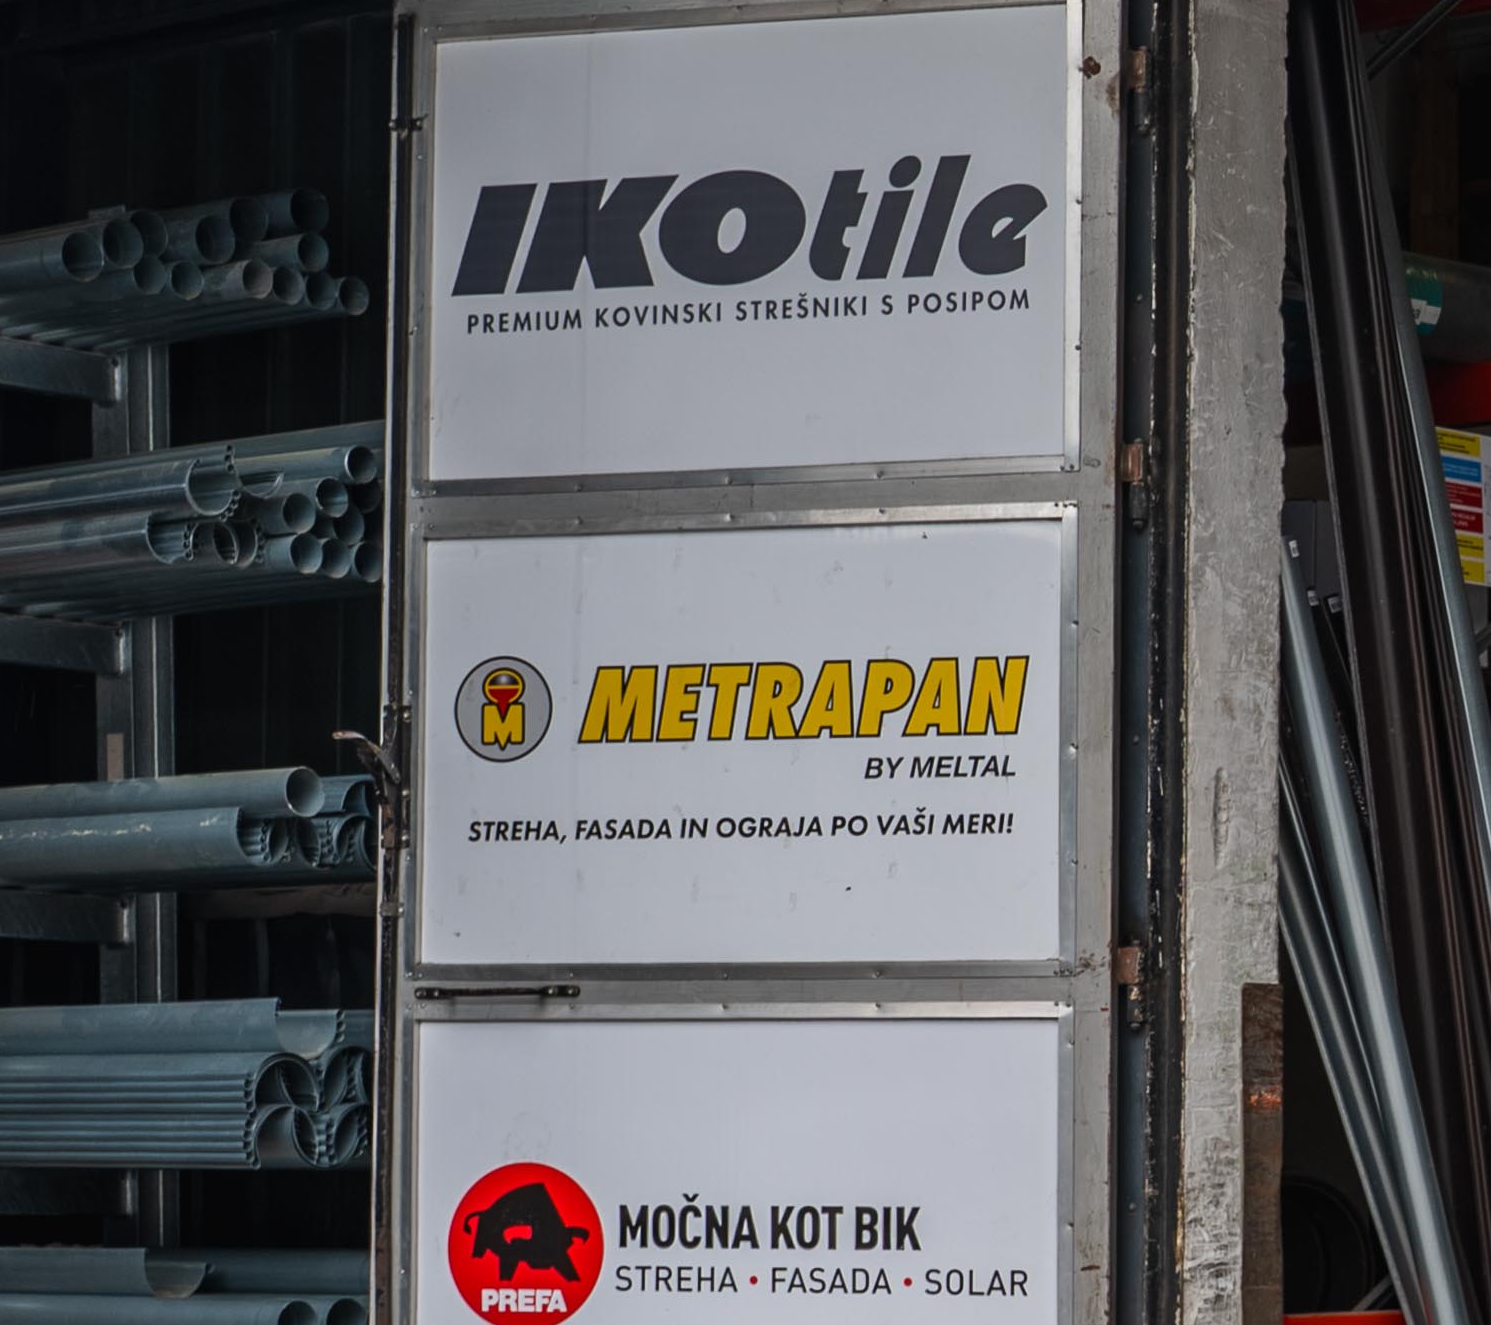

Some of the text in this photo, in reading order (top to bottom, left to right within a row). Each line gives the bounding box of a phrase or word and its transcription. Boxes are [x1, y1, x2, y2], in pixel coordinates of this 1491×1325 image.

[451, 155, 1047, 296] IKOtile
[468, 289, 1029, 334] PREMIUM KOVINSKI STREŠNIKI S POSIPOM
[577, 654, 1030, 744] METRAPAN
[865, 755, 1015, 779] BY MELTAL
[469, 807, 1013, 844] STREHA, FASADA IN OGRAJA PO VAŠI MERI!
[620, 1194, 920, 1250] MOČNA KOT BIK
[480, 1287, 567, 1314] PREFA
[616, 1266, 1027, 1296] STREHA FASADA SOLAR
